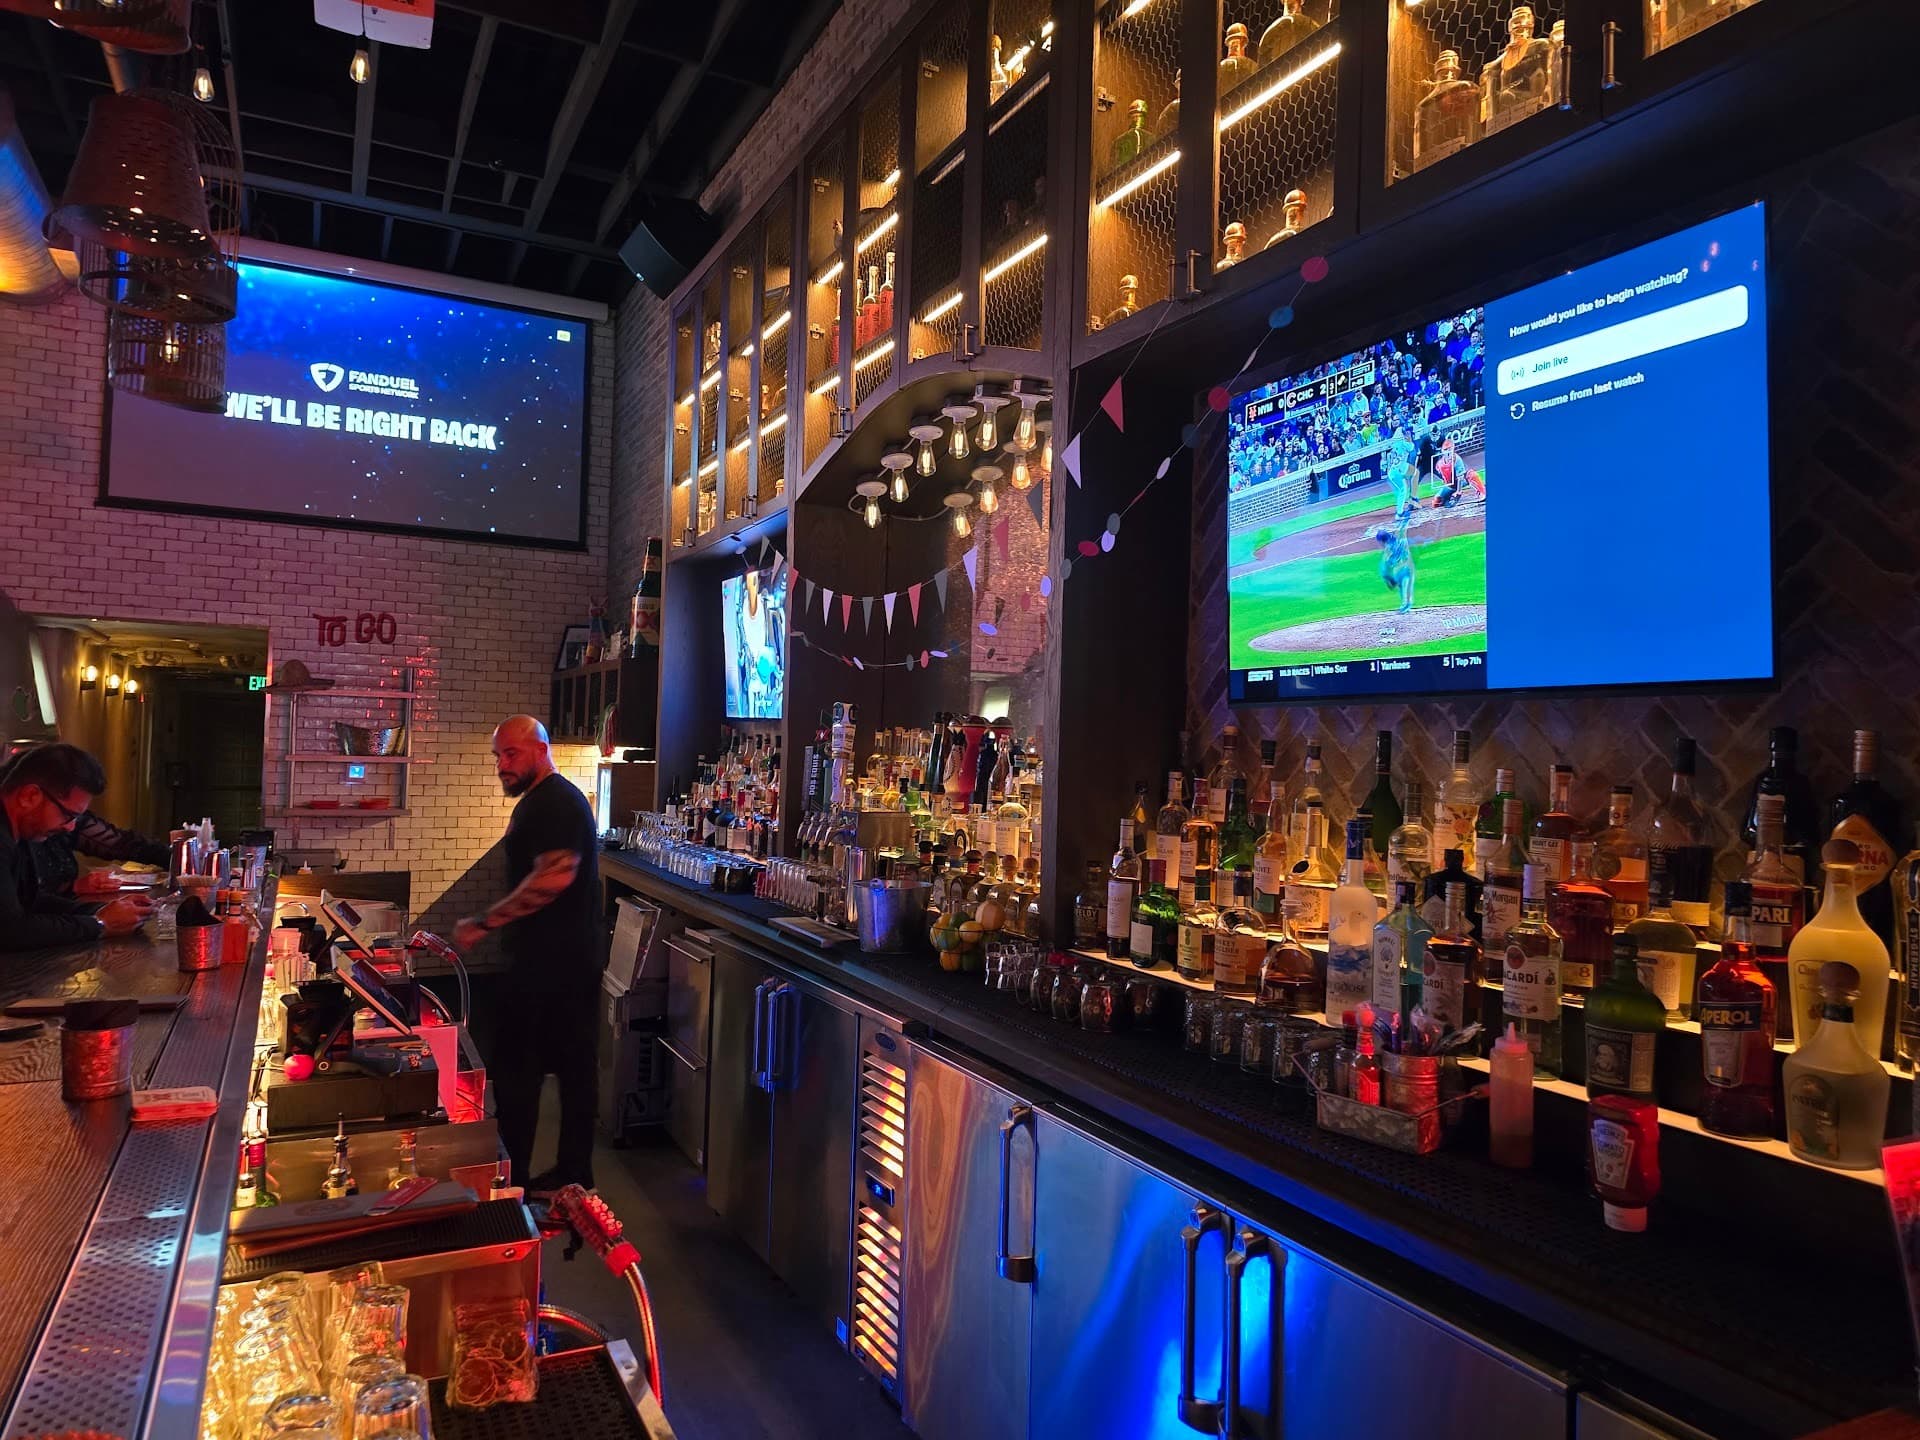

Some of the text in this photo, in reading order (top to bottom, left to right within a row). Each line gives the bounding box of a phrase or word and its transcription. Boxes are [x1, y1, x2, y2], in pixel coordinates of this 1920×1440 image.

[1509, 268, 1689, 338] How would you like to begin watching?
[1532, 355, 1569, 373] Join live
[348, 370, 419, 391] FANDUEL
[348, 383, 419, 400] SPORTS NETWORK
[1296, 388, 1314, 401] CHC
[1319, 383, 1327, 396] 2
[1531, 371, 1645, 411] Resume from last watch
[306, 402, 341, 431] BE
[345, 407, 426, 441] RIGHT
[429, 418, 497, 451] BACK
[1337, 469, 1372, 489] Corona
[355, 613, 397, 644] GO
[1314, 665, 1333, 675] White
[1334, 664, 1348, 674] Sox
[1380, 660, 1411, 671] Yankees
[1442, 655, 1482, 668] 5 Top 7th
[1247, 669, 1274, 682] ESPN
[808, 754, 820, 796] DOS EQUIS
[1751, 905, 1791, 924] PARI
[1503, 969, 1540, 985] ACARDÍ
[1701, 1006, 1753, 1025] APEROL
